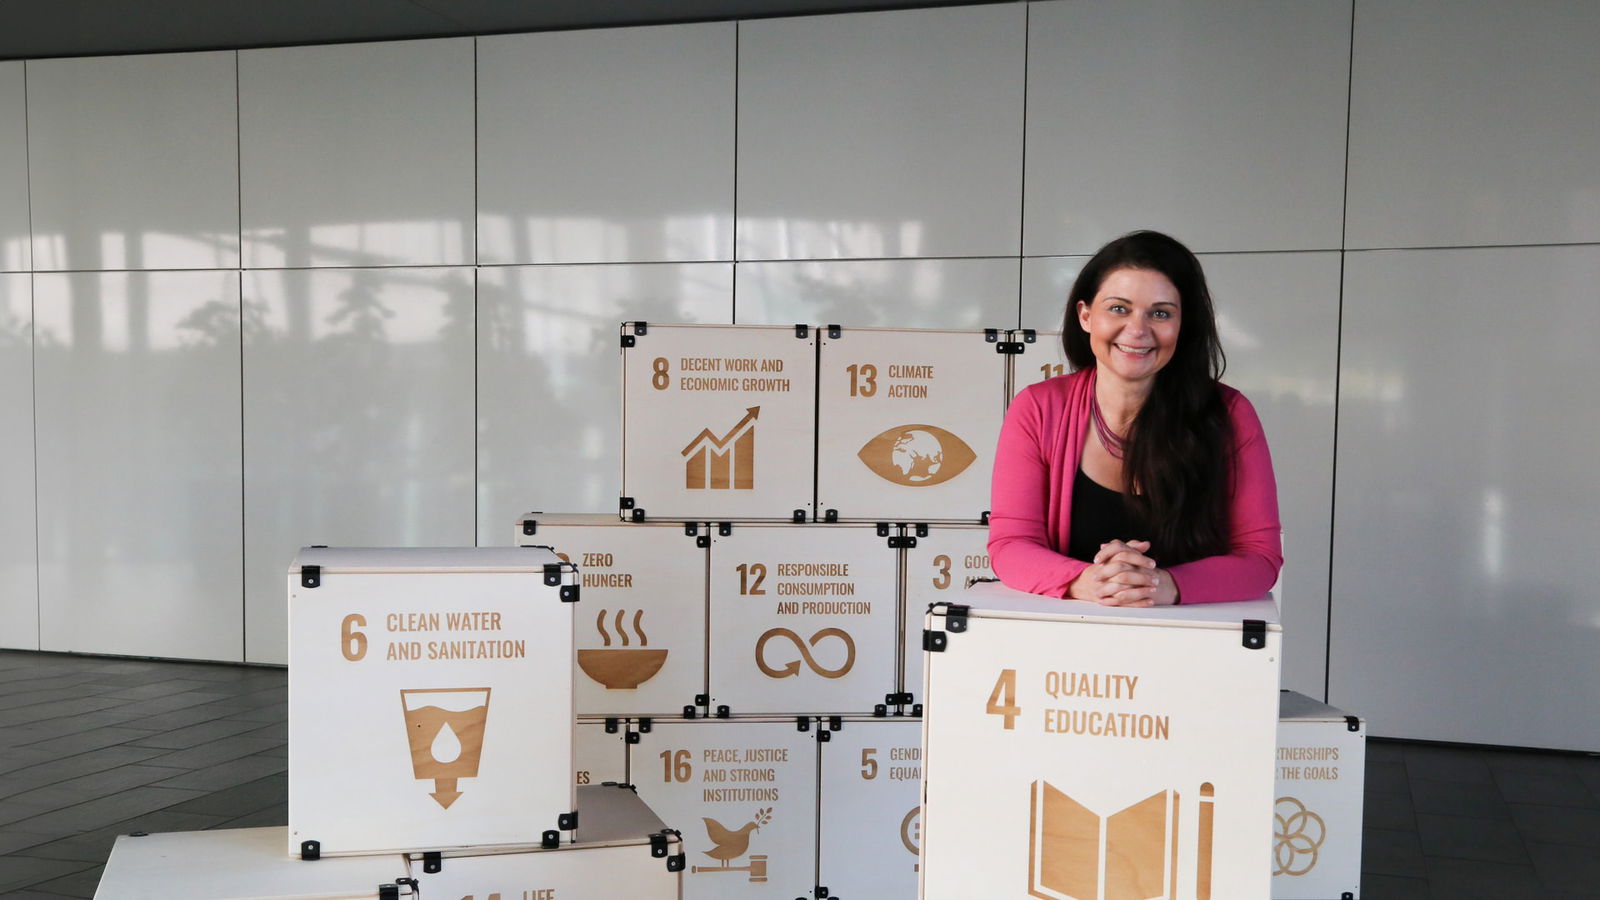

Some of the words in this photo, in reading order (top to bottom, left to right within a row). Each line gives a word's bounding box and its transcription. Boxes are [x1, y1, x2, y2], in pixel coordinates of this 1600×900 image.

[680, 357, 721, 372] DECENT
[724, 358, 758, 373] WORK
[761, 359, 784, 373] AND
[888, 365, 934, 380] CLIMATE
[651, 357, 671, 391] 8
[846, 364, 878, 398] 13
[680, 377, 740, 392] ECONOMIC
[742, 378, 791, 393] GROWTH
[888, 383, 928, 399] ACTION
[582, 552, 614, 568] ZERO
[964, 555, 990, 569] GOO
[777, 563, 849, 578] RESPONSIBLE
[932, 554, 952, 590] 3
[582, 573, 633, 588] HUNGER
[735, 563, 768, 597] 12
[777, 582, 855, 597] CONSUMPTION
[777, 601, 800, 615] AND
[802, 601, 871, 616] PRODUCTION
[386, 613, 440, 633] CLEAN
[445, 612, 502, 632] WATER
[340, 613, 369, 663] 6
[386, 641, 422, 661] AND
[427, 639, 526, 660] SANITATION
[1044, 670, 1139, 700] QUALITY
[985, 668, 1022, 731] 4
[1043, 709, 1170, 741] EDUCATION
[703, 749, 742, 764] PEACE,
[744, 748, 789, 763] JUSTICE
[659, 749, 692, 784] 16
[860, 748, 879, 781] 5
[703, 768, 727, 783] AND
[730, 768, 776, 783] STRONG
[889, 767, 922, 782] EQUA
[1281, 766, 1301, 780] THE
[1303, 766, 1339, 781] GOALS
[703, 787, 780, 803] INSTITUTIONS
